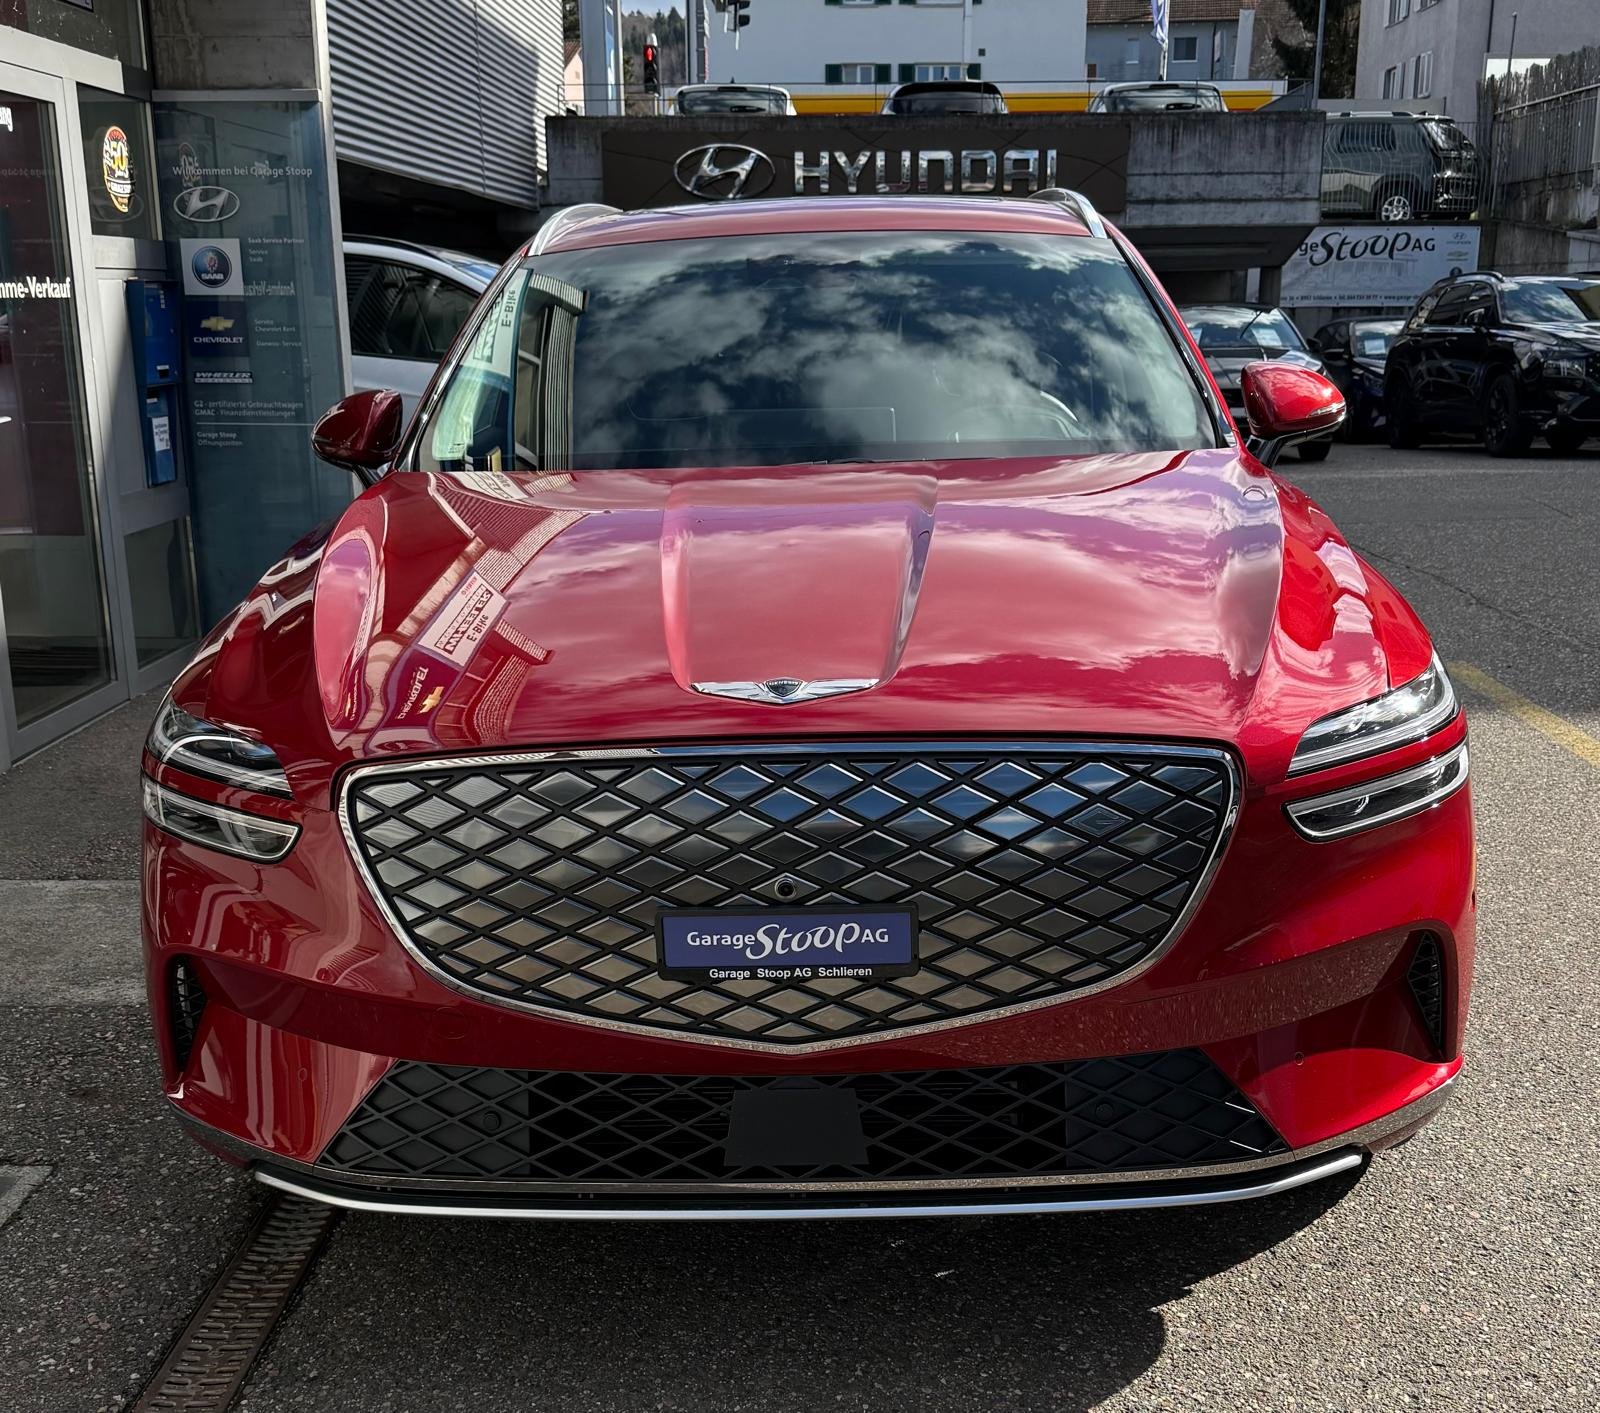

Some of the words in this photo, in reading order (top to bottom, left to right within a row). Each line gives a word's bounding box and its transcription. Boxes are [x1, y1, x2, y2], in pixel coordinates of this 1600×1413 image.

[172, 166, 232, 176] Willkommen
[234, 166, 248, 176] bei
[250, 166, 284, 178] Garage
[285, 166, 313, 178] Stoop
[794, 149, 1057, 193] HYUNDAI
[1309, 232, 1412, 267] Stoop
[1412, 238, 1436, 251] AG
[193, 336, 244, 344] CHEVROLET
[686, 931, 755, 949] Garage
[745, 922, 861, 960] Stoop
[861, 928, 889, 943] AG
[709, 968, 750, 980] Garage
[757, 968, 791, 979] Stoop
[793, 967, 812, 977] AG
[818, 967, 872, 977] Schlieren
